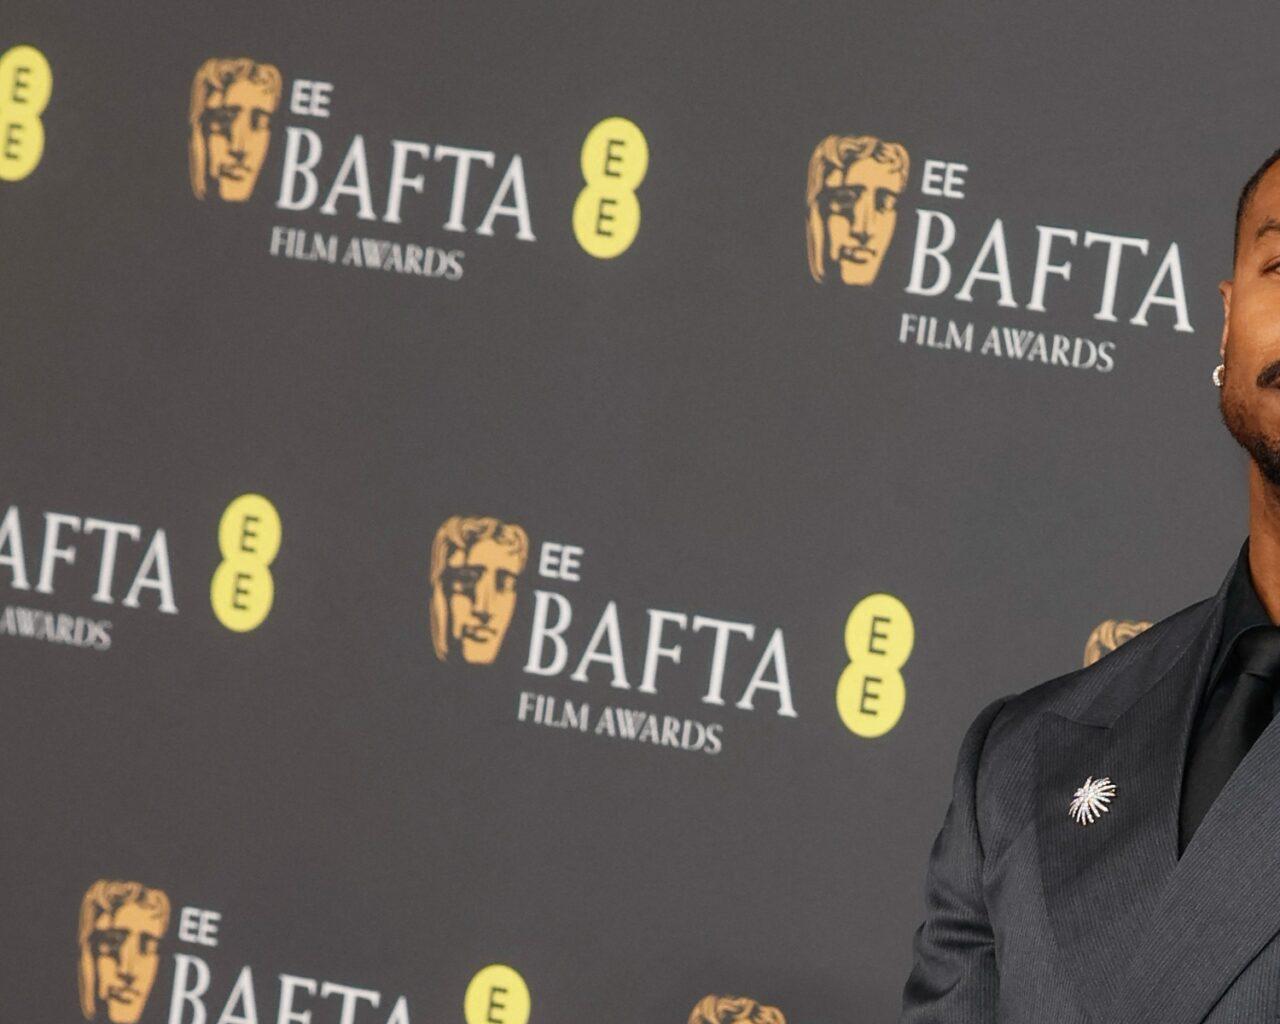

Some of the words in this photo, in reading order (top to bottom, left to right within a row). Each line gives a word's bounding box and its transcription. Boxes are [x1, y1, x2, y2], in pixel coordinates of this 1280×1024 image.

[289, 78, 334, 118] EE
[274, 125, 537, 243] BAFTA
[920, 159, 969, 200] EE
[269, 226, 338, 264] FILM
[342, 236, 466, 281] AWARDS
[904, 208, 1195, 334] BAFTA
[899, 312, 974, 353] FILM
[980, 326, 1116, 372] AWARDS
[538, 541, 585, 582] EE
[522, 589, 798, 719] BAFTA
[517, 691, 590, 732] FILM
[594, 706, 723, 755] AWARDS
[177, 906, 222, 947] EE
